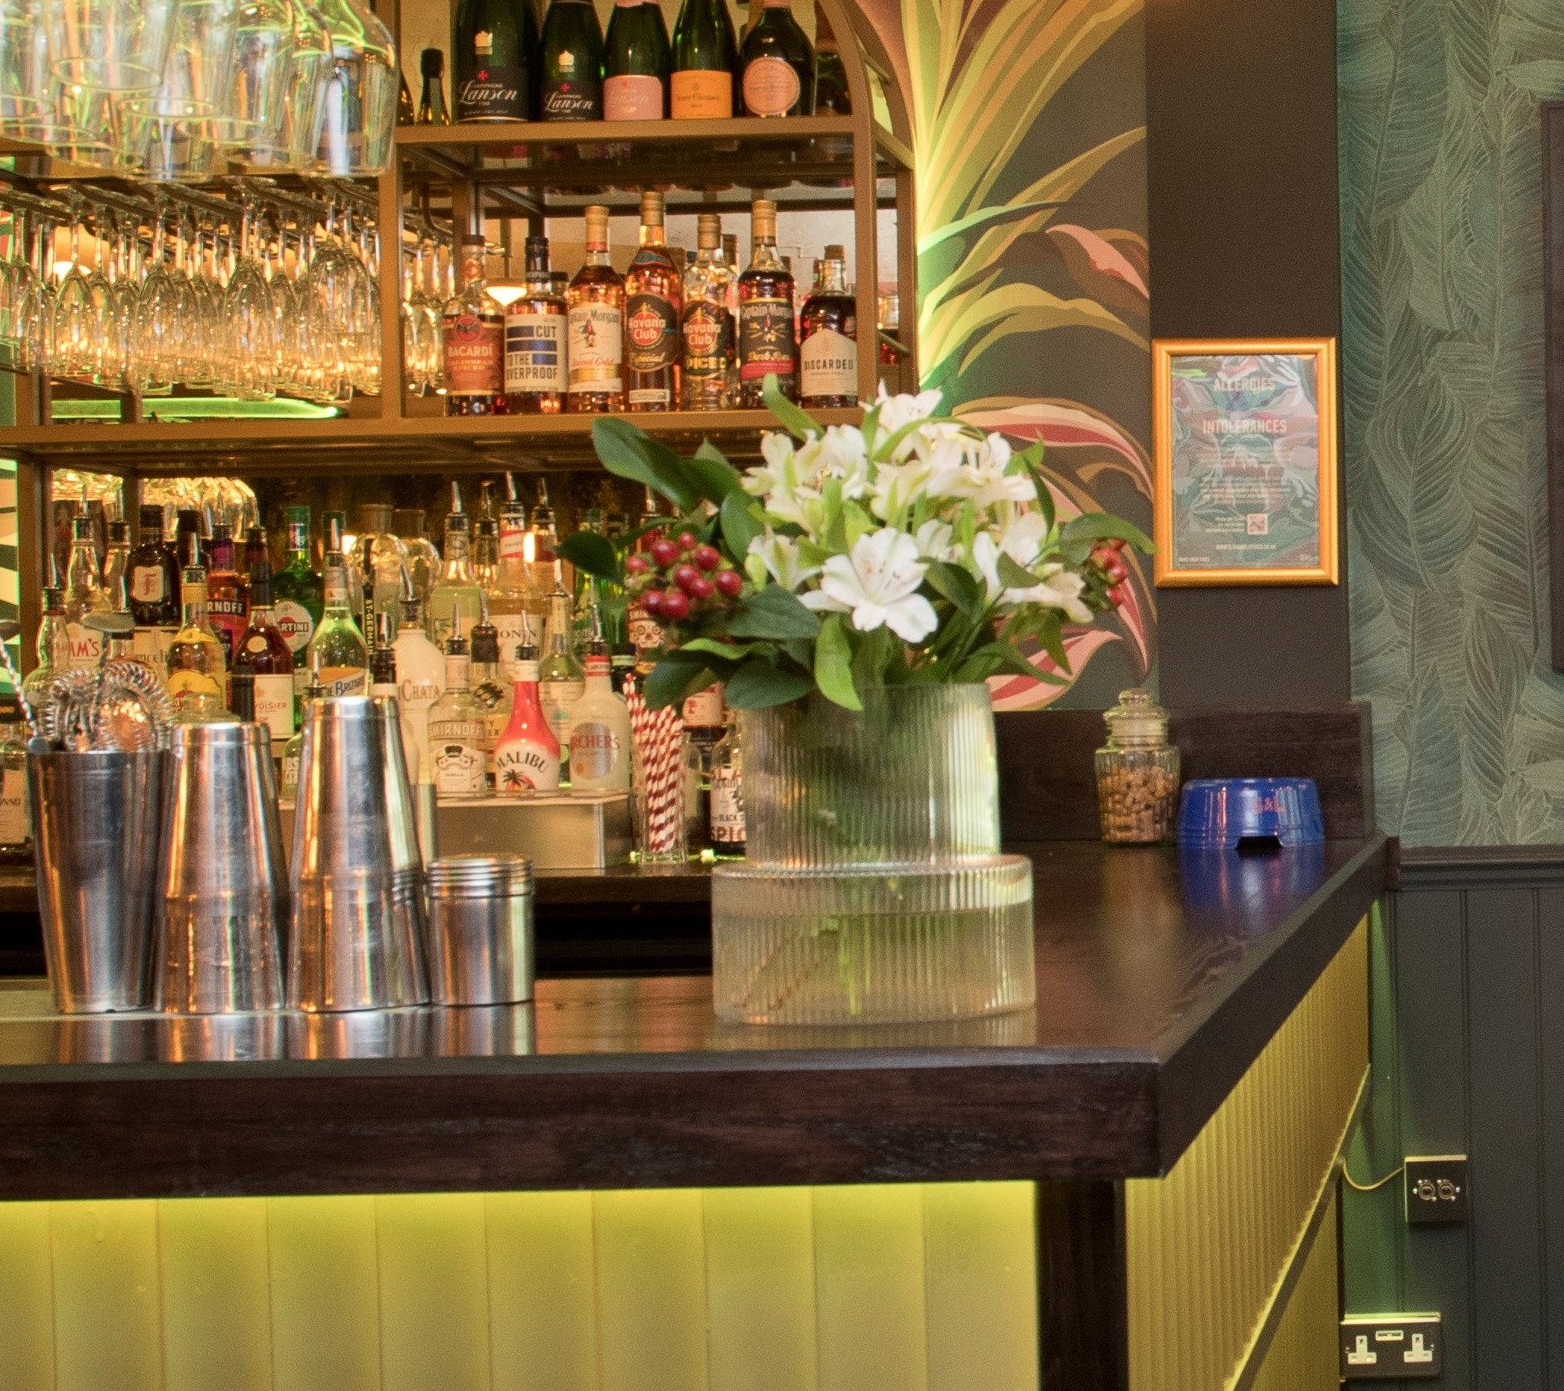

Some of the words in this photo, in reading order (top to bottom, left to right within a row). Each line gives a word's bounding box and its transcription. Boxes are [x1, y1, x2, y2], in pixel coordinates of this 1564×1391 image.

[459, 80, 518, 106] Lanson
[544, 90, 594, 113] Lanson
[628, 317, 667, 329] Havana
[682, 321, 722, 335] Havana
[535, 325, 558, 338] CUT
[633, 327, 658, 341] Club
[687, 332, 714, 346] Club
[514, 352, 530, 366] THE
[803, 358, 855, 371] DISCARDED
[506, 366, 558, 380] OVERPROOF
[1213, 376, 1276, 393] ALLERGIES
[1201, 418, 1288, 435] INTOLERANCES
[207, 601, 244, 614] RNOFF
[254, 702, 287, 710] VOISIER
[495, 751, 550, 774] MALIBU
